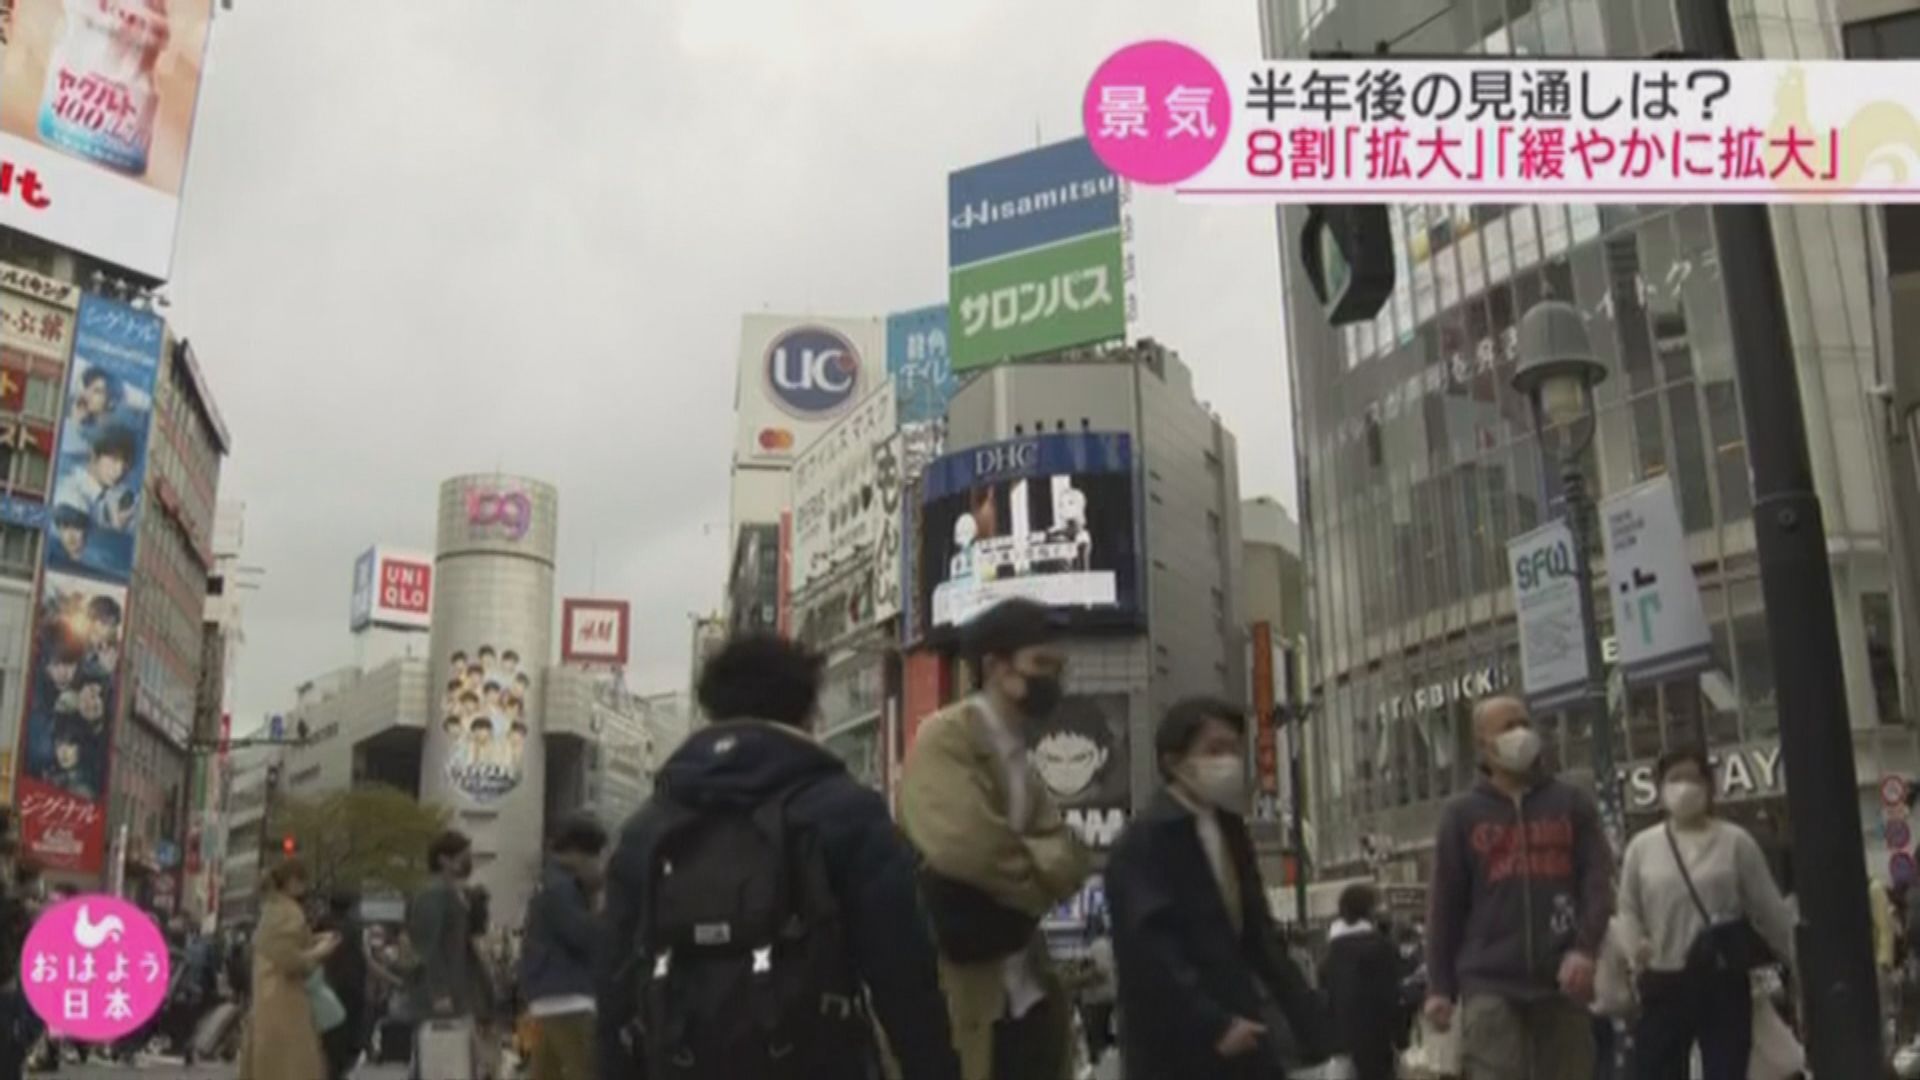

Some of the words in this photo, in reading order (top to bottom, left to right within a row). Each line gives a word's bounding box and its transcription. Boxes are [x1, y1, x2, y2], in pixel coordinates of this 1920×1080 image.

[57, 67, 137, 117] ヤクルト
[951, 174, 1116, 230] Hisamitsu
[960, 264, 1113, 336] サロンパス
[773, 347, 853, 393] UC
[975, 442, 1039, 475] DHC
[384, 585, 425, 608] QLO
[385, 565, 423, 585] UNI
